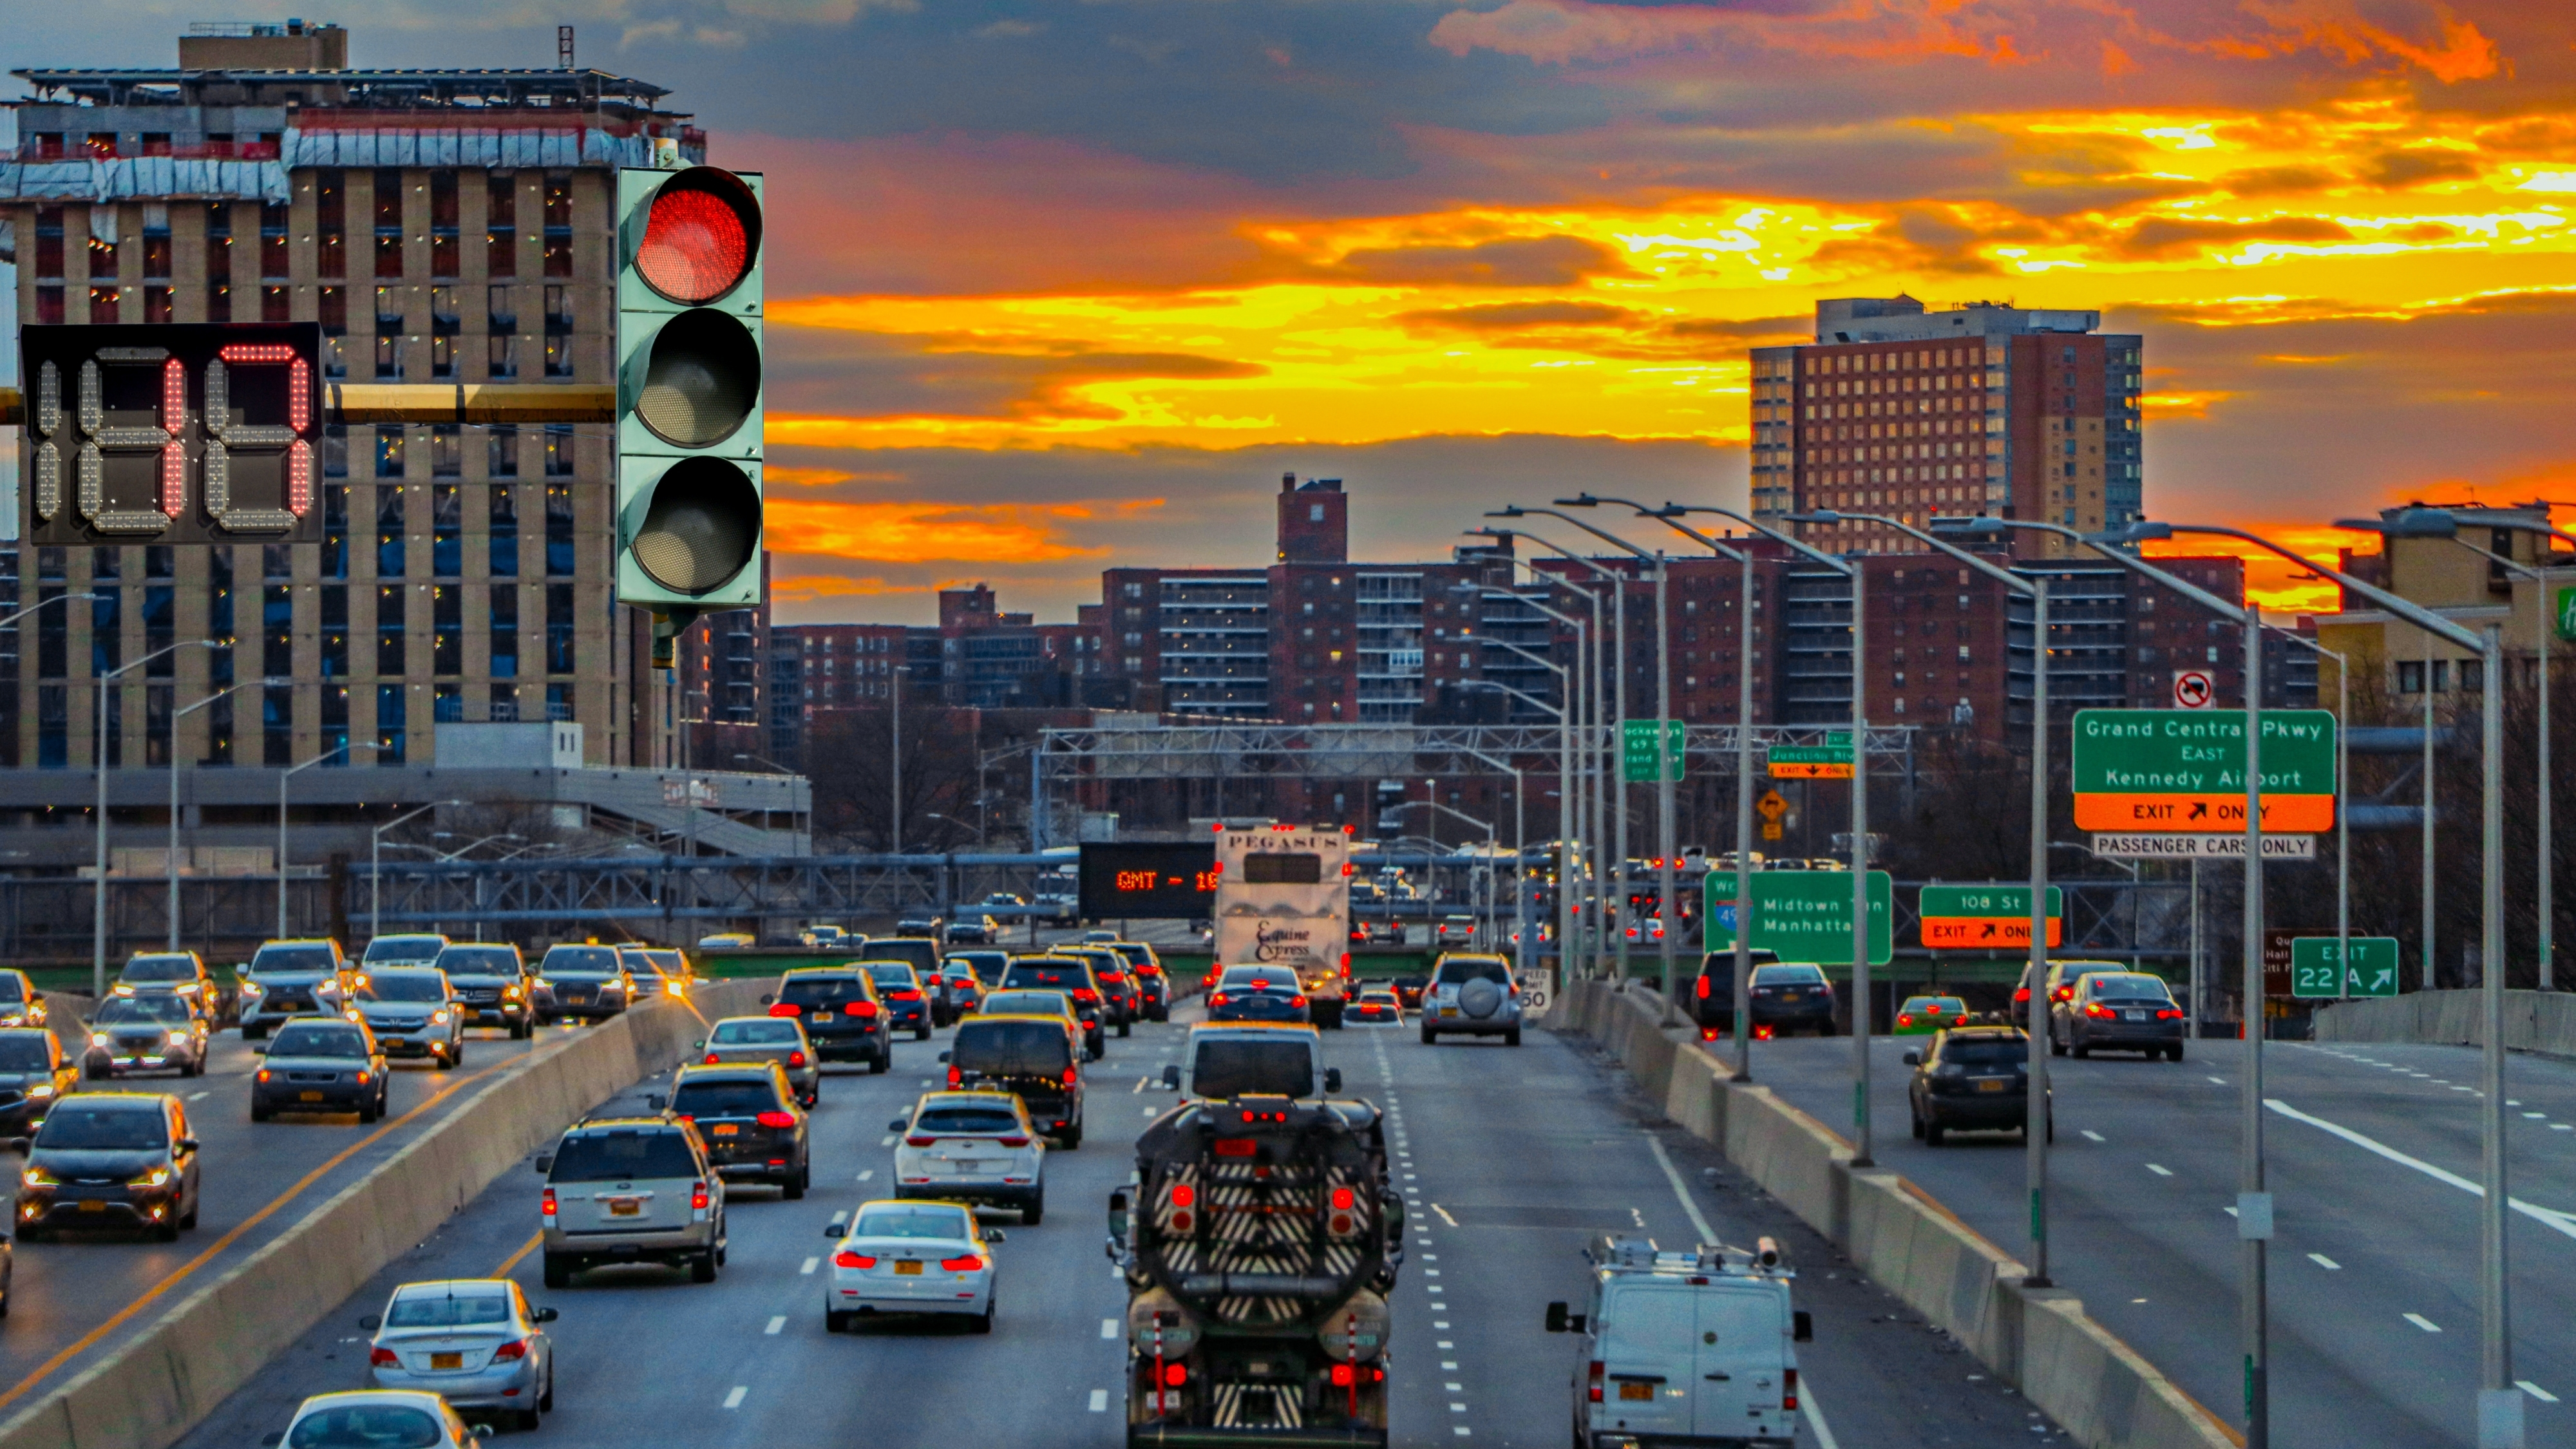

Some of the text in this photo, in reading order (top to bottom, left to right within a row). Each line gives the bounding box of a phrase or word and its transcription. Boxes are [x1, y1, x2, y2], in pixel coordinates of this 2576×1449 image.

[2087, 719, 2322, 741] Grand Centra Pkwy
[1772, 750, 1828, 760] Junction
[2182, 745, 2224, 761] EAST
[2106, 770, 2202, 790] Kennedy
[2134, 804, 2270, 819] EXIT ONY
[1229, 836, 1338, 849] PEGASUS
[2098, 837, 2196, 853] PASSENGER
[2262, 838, 2307, 854] ONLY
[1765, 899, 1839, 911] Midtown
[1962, 895, 2020, 909] 108 St
[1256, 920, 1309, 944] Equine
[1765, 919, 1852, 931] Manhatta
[1933, 925, 1966, 938] EXIT
[1255, 945, 1309, 962] Express
[2266, 950, 2288, 959] Hall
